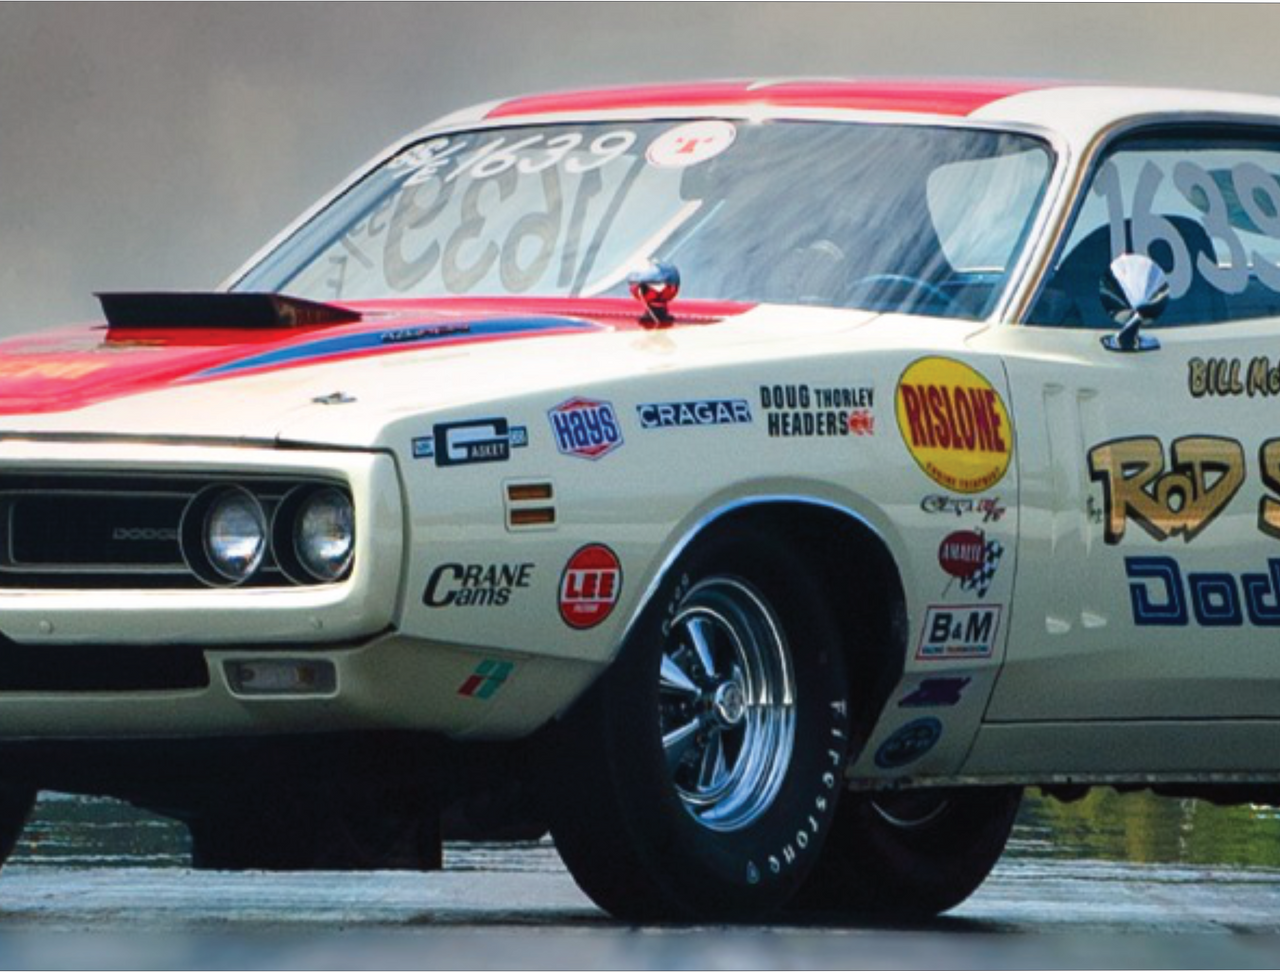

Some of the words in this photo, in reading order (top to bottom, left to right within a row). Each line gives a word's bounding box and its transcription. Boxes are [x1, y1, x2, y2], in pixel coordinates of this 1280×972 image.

[443, 130, 637, 183] 1639
[1188, 356, 1243, 398] BILL
[759, 385, 811, 410] DOUG
[813, 387, 875, 409] THORLEY
[638, 402, 752, 429] CRAGAR
[767, 410, 850, 438] HEADERS
[900, 384, 1008, 453] RISLONE
[565, 572, 615, 599] LEE
[929, 611, 993, 643] B&M
